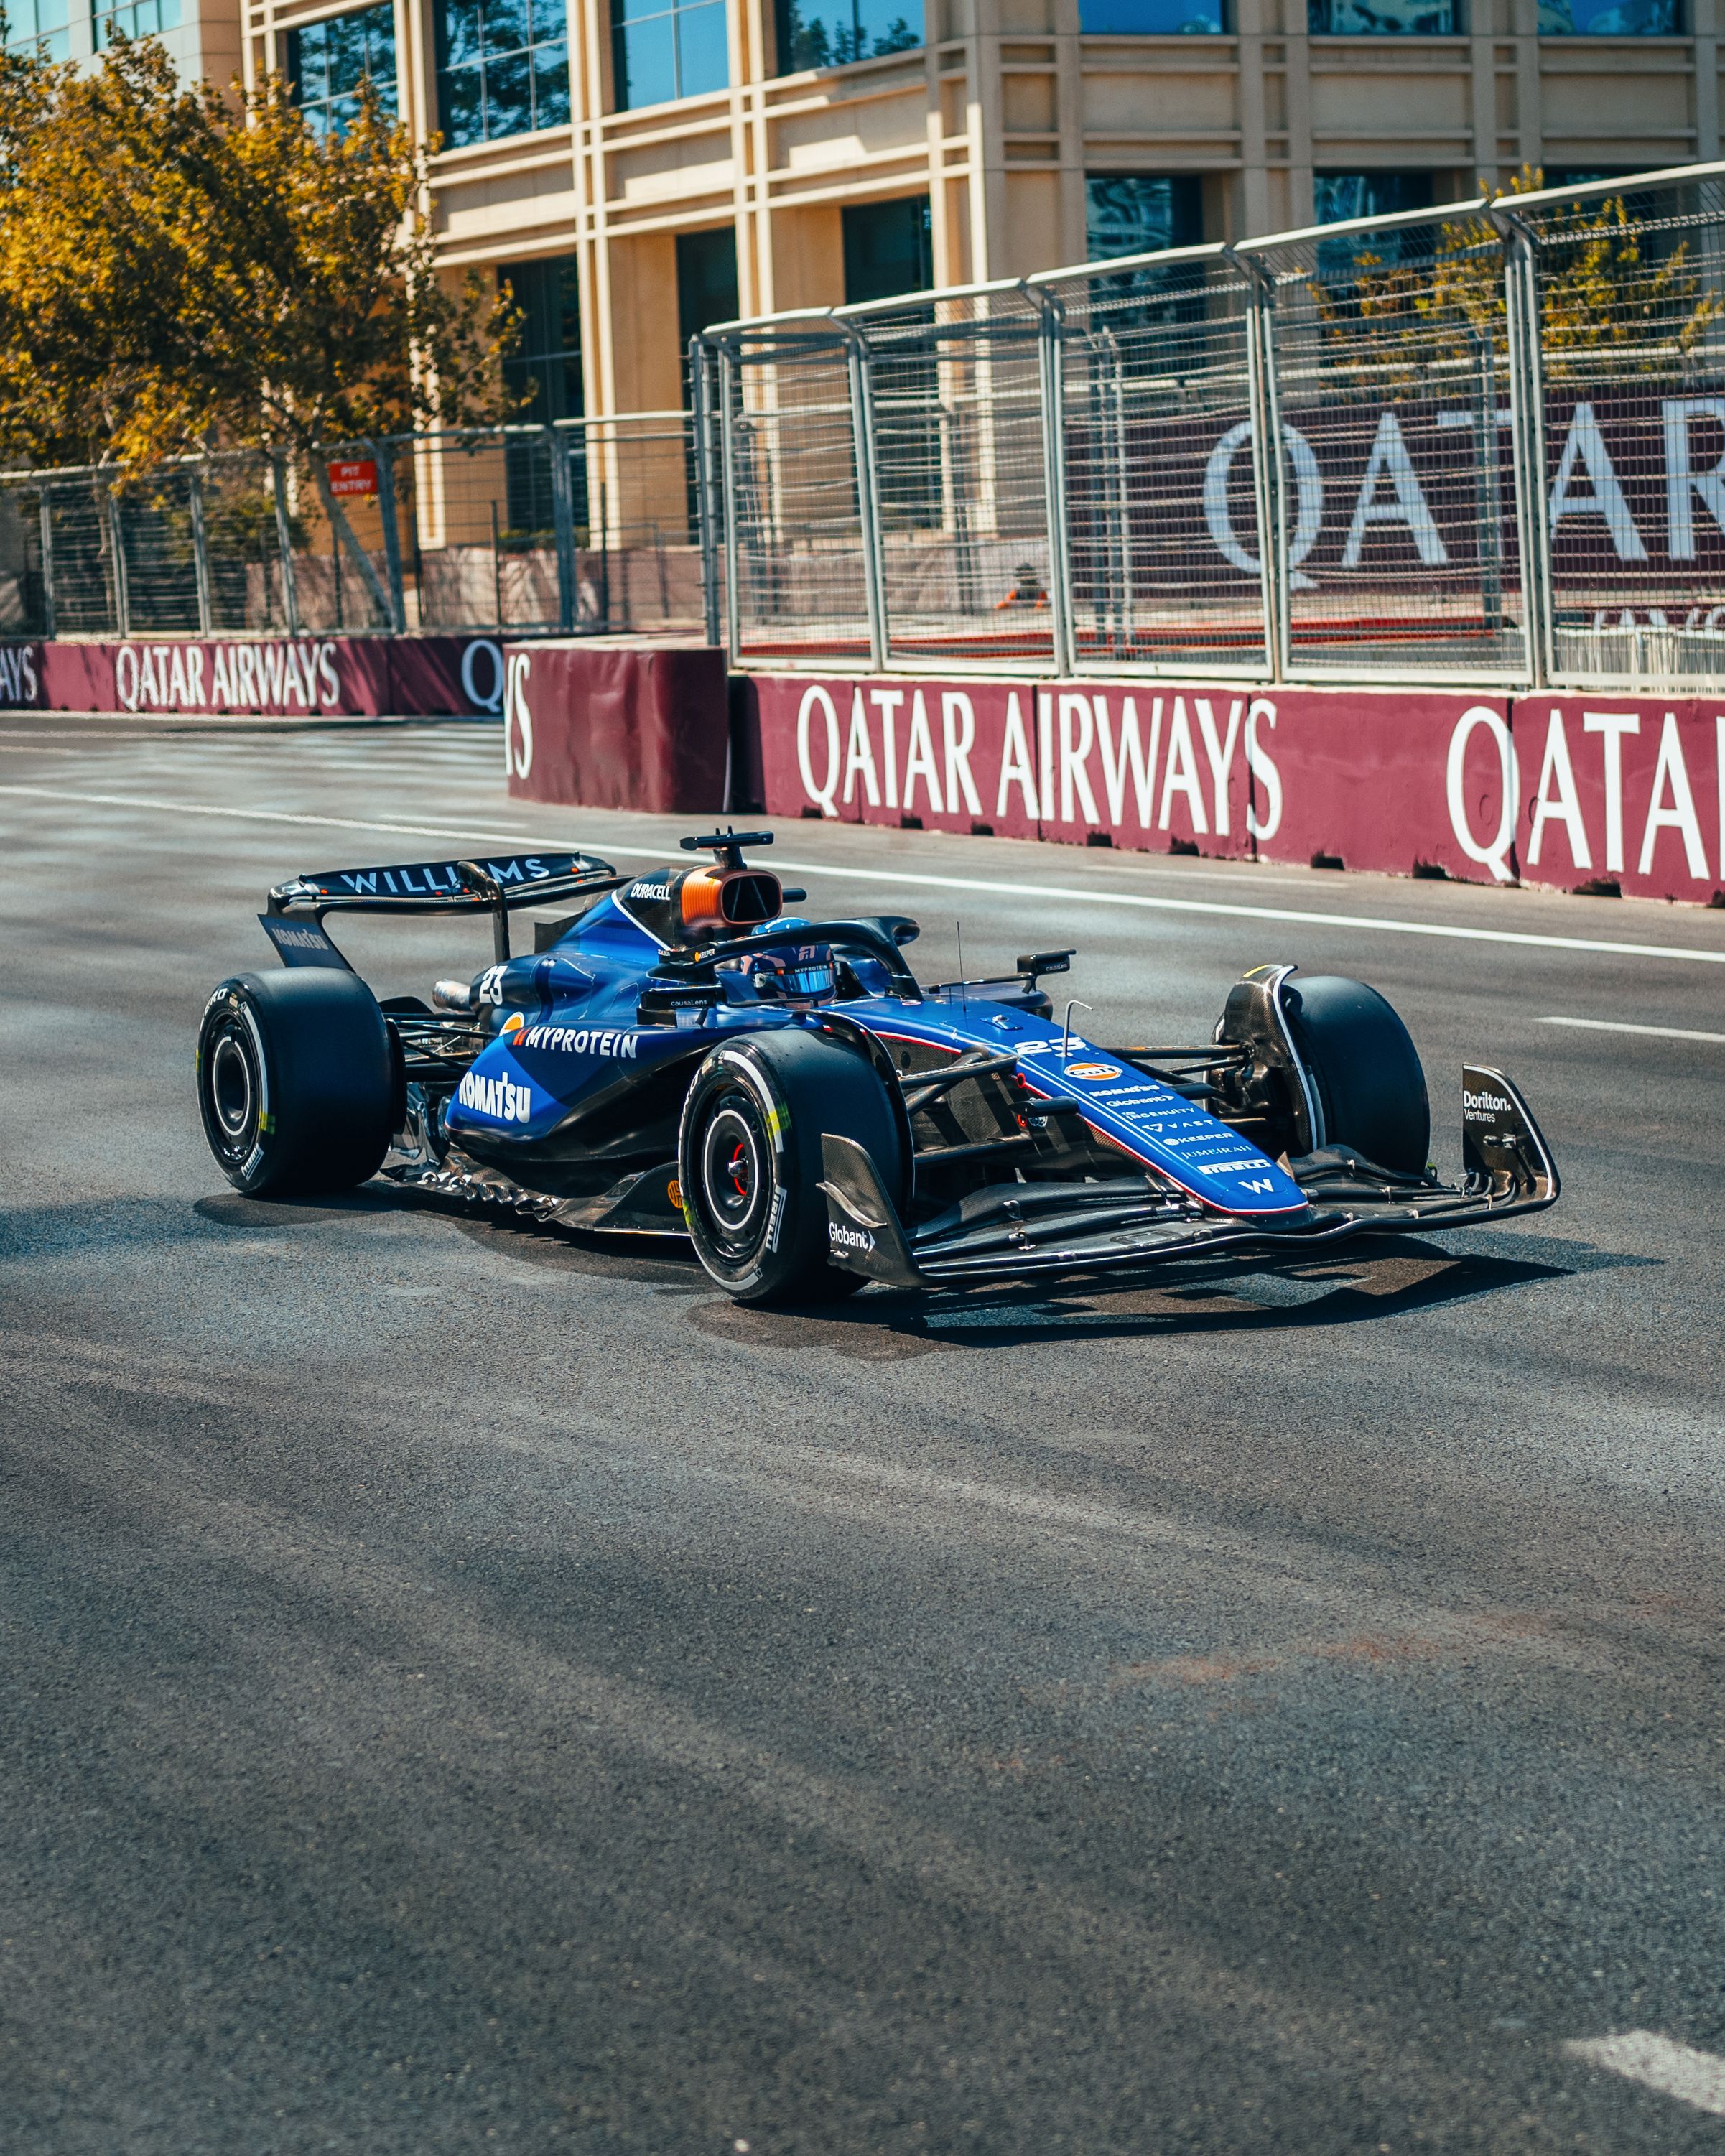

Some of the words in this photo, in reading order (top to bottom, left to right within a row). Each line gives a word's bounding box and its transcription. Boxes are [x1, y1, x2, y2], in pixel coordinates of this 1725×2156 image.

[341, 465, 359, 477] PIT
[331, 479, 371, 493] ENTRY
[116, 646, 207, 712] QATAR
[212, 643, 340, 707] AIRWAYS
[796, 684, 982, 817] QATAR
[997, 691, 1283, 841] AIRWAYS
[1446, 705, 1725, 882] QATA
[340, 858, 550, 894] WILLIMS
[631, 883, 671, 901] DURACELL
[271, 928, 328, 950] KOMATSU
[699, 948, 715, 959] KEEPER
[794, 965, 828, 973] MYPROTEIN
[479, 965, 508, 1005] 23
[525, 1026, 638, 1059] MYPROTEIN
[1014, 1037, 1087, 1058] 23
[459, 1071, 531, 1123] KOMATSU
[1106, 1096, 1166, 1107] Globant
[1126, 1107, 1195, 1121] INGENUITY
[1464, 1108, 1496, 1123] Ventures
[1178, 1133, 1235, 1144] KEEPER
[1181, 1146, 1252, 1160] JUMEIRAH
[1196, 1158, 1272, 1175] PIRELLI
[828, 1222, 868, 1250] Globant
